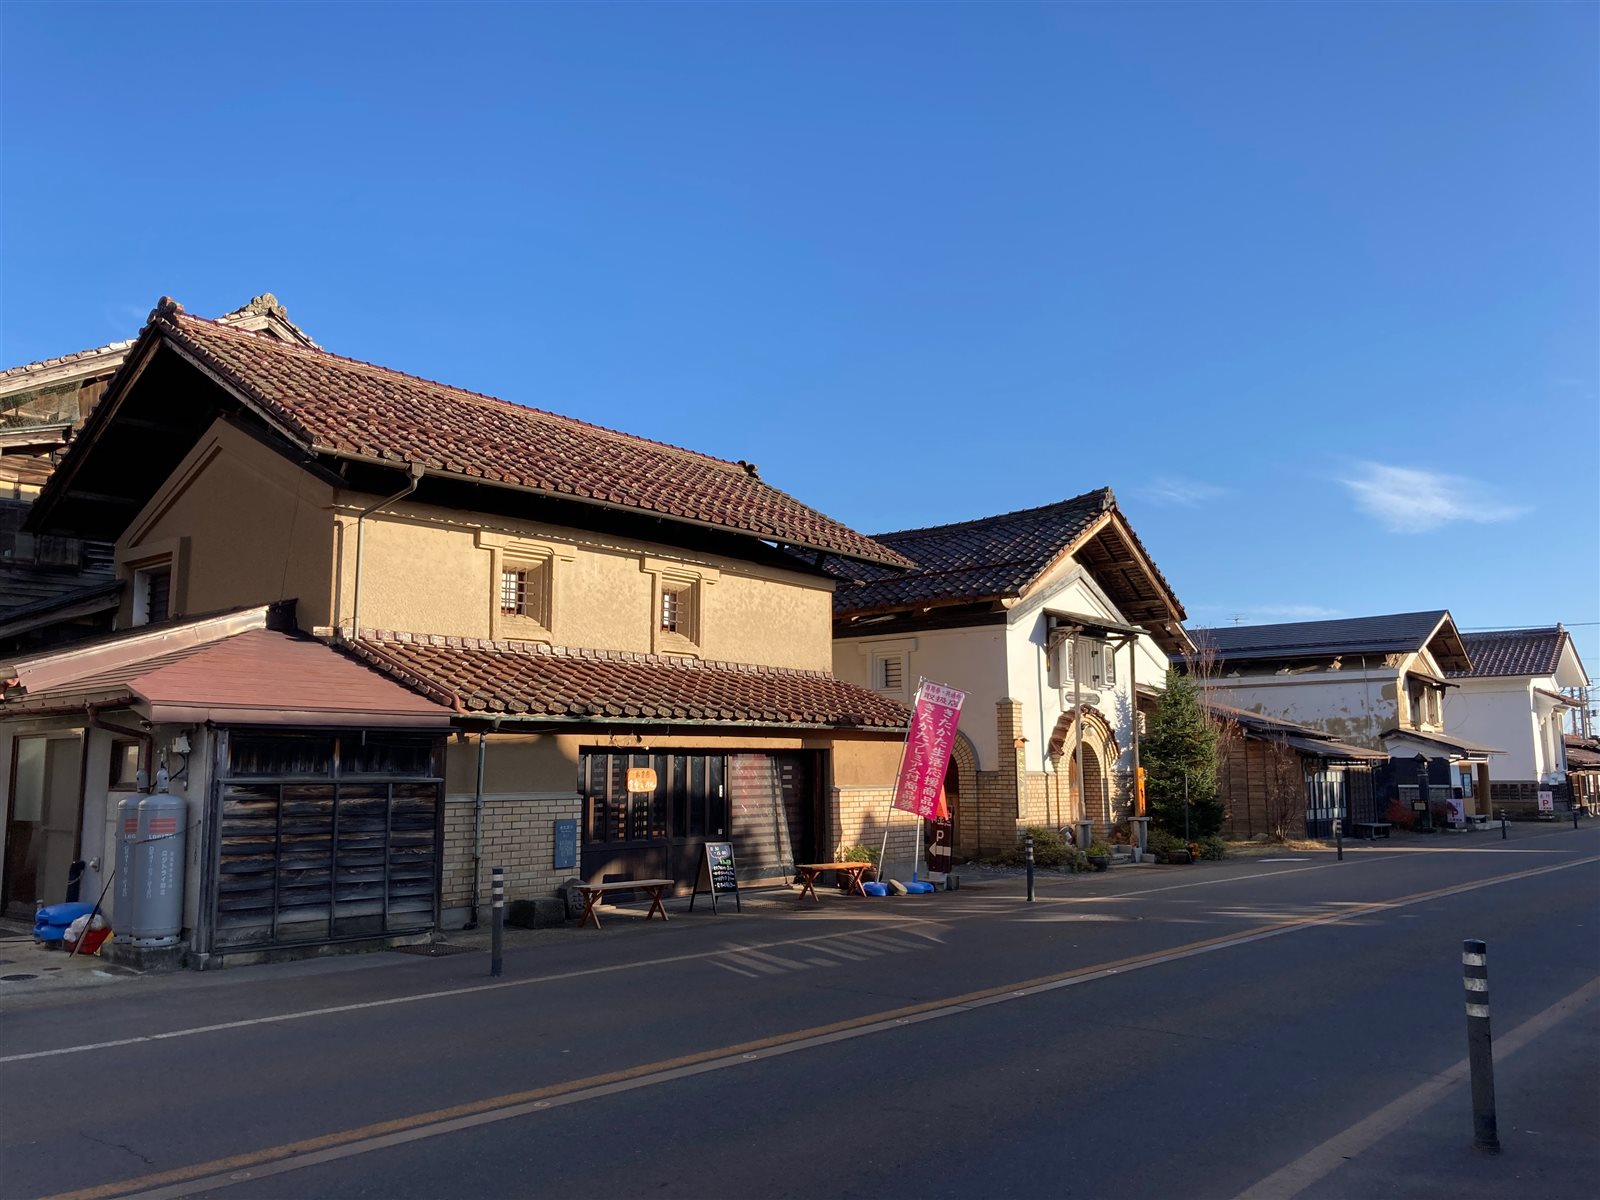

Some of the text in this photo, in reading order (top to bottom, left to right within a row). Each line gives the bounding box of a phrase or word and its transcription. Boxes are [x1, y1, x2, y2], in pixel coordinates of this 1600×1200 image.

[923, 692, 959, 708] 取扱店
[900, 703, 936, 810] きたかたプレミアム付商品券
[918, 708, 954, 816] きたかた生活応援商品券
[1542, 799, 1549, 807] P
[936, 830, 945, 842] P
